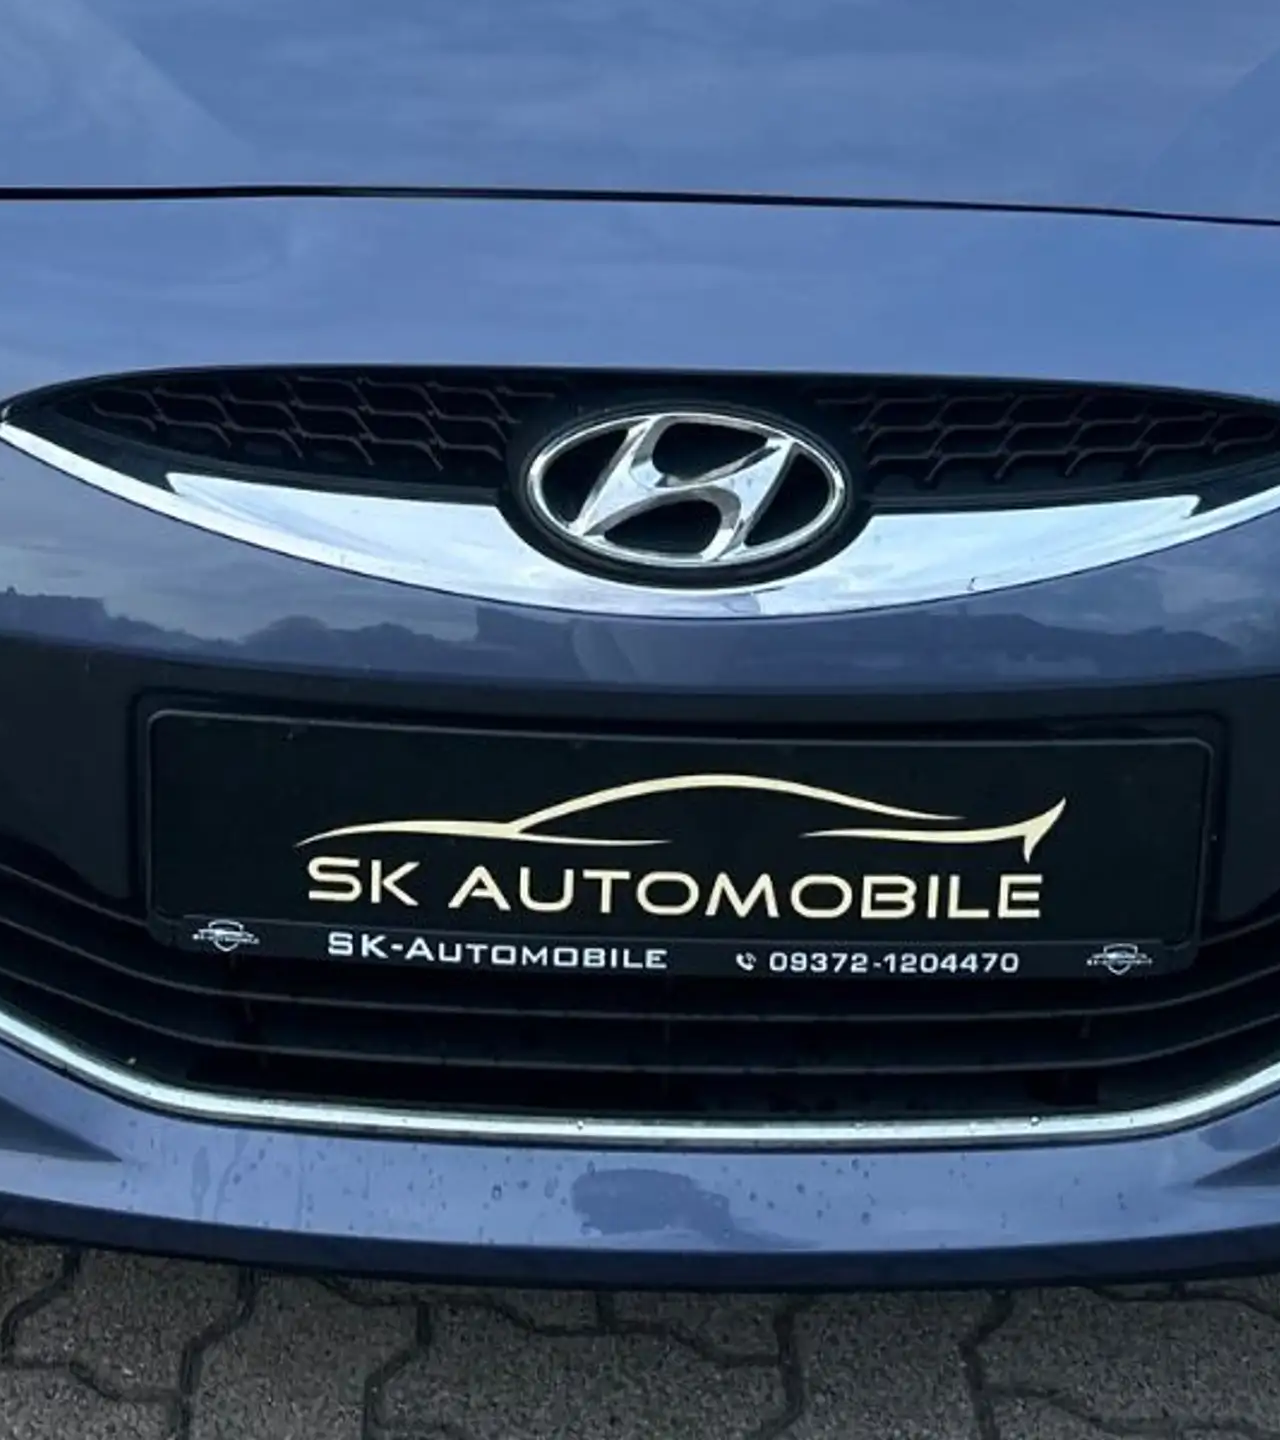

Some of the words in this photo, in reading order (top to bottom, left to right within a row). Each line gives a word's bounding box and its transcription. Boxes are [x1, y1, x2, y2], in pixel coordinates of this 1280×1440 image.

[307, 856, 420, 907] SK
[447, 864, 1043, 919] AUTOMOBILE
[768, 951, 1020, 974] 09372-1204470
